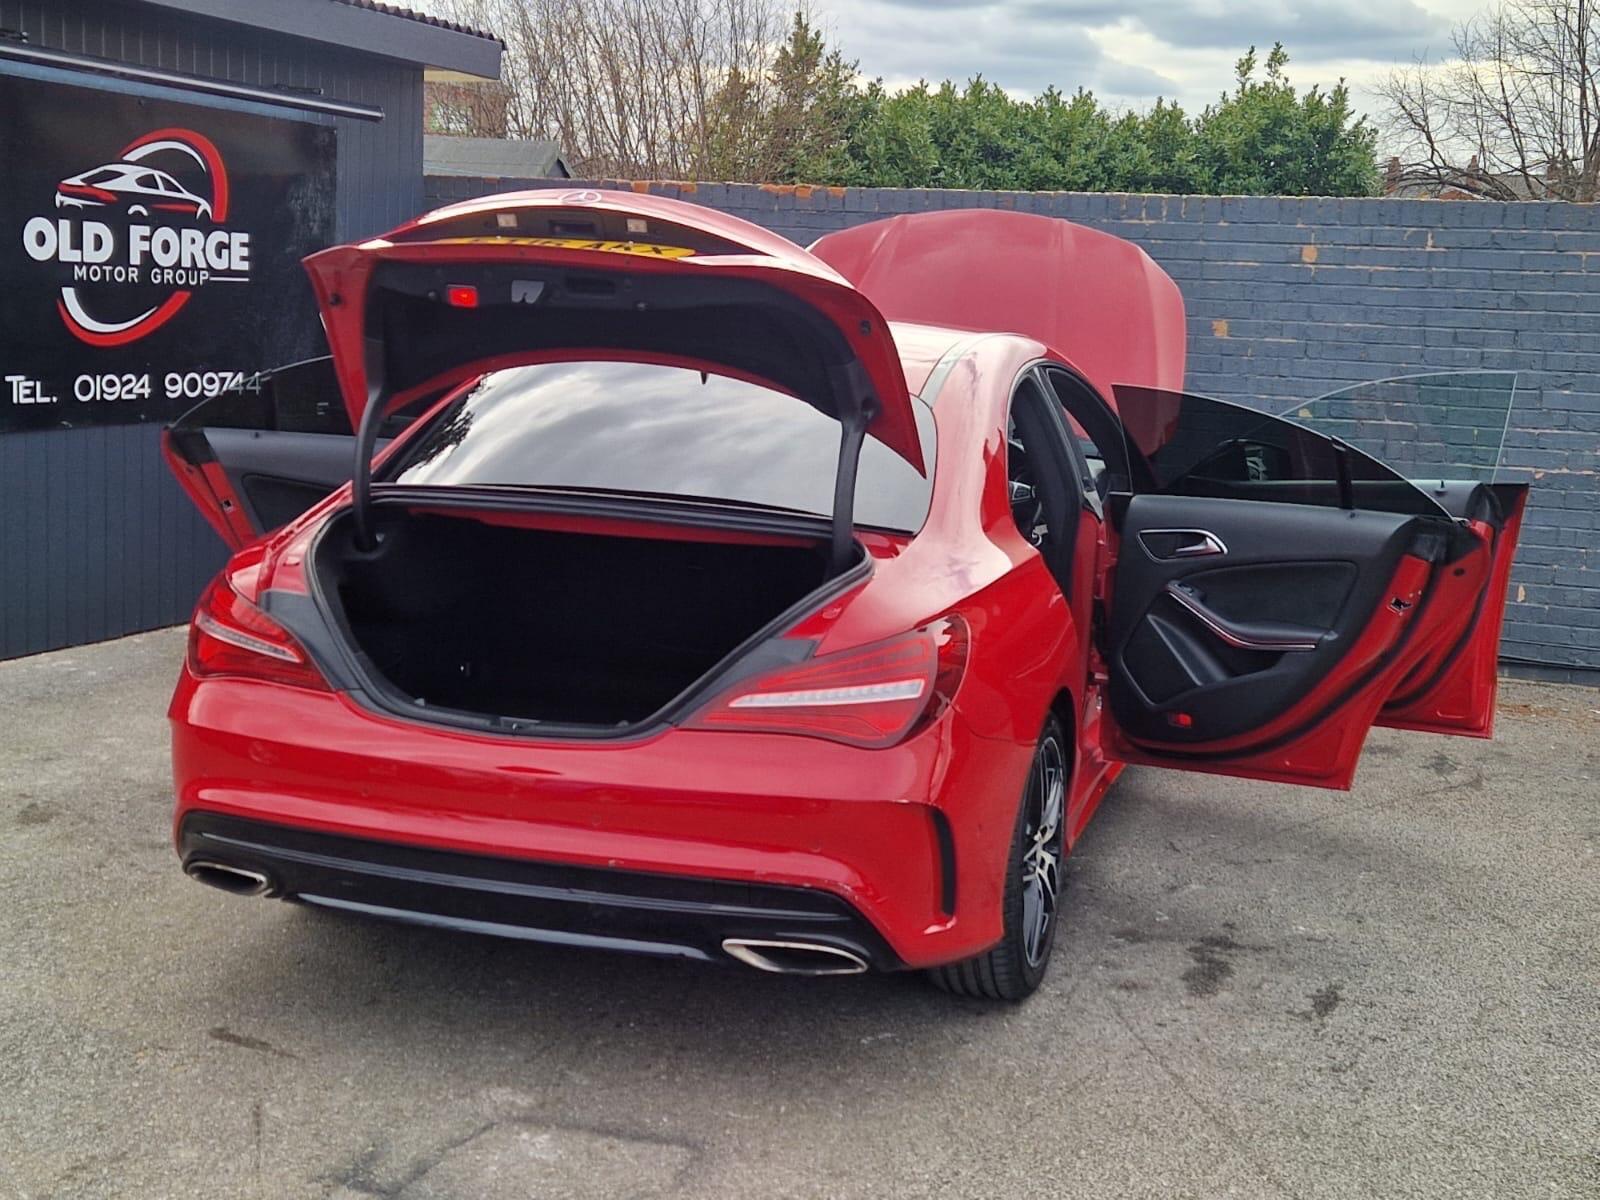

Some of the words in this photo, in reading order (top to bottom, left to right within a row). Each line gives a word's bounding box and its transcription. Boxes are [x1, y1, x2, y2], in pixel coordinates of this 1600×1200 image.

[23, 216, 114, 263] OLD
[129, 224, 249, 271] FORGE
[73, 264, 139, 283] MOTOR
[151, 268, 209, 286] GROUP
[74, 374, 151, 402] 01924
[164, 371, 262, 398] 909744
